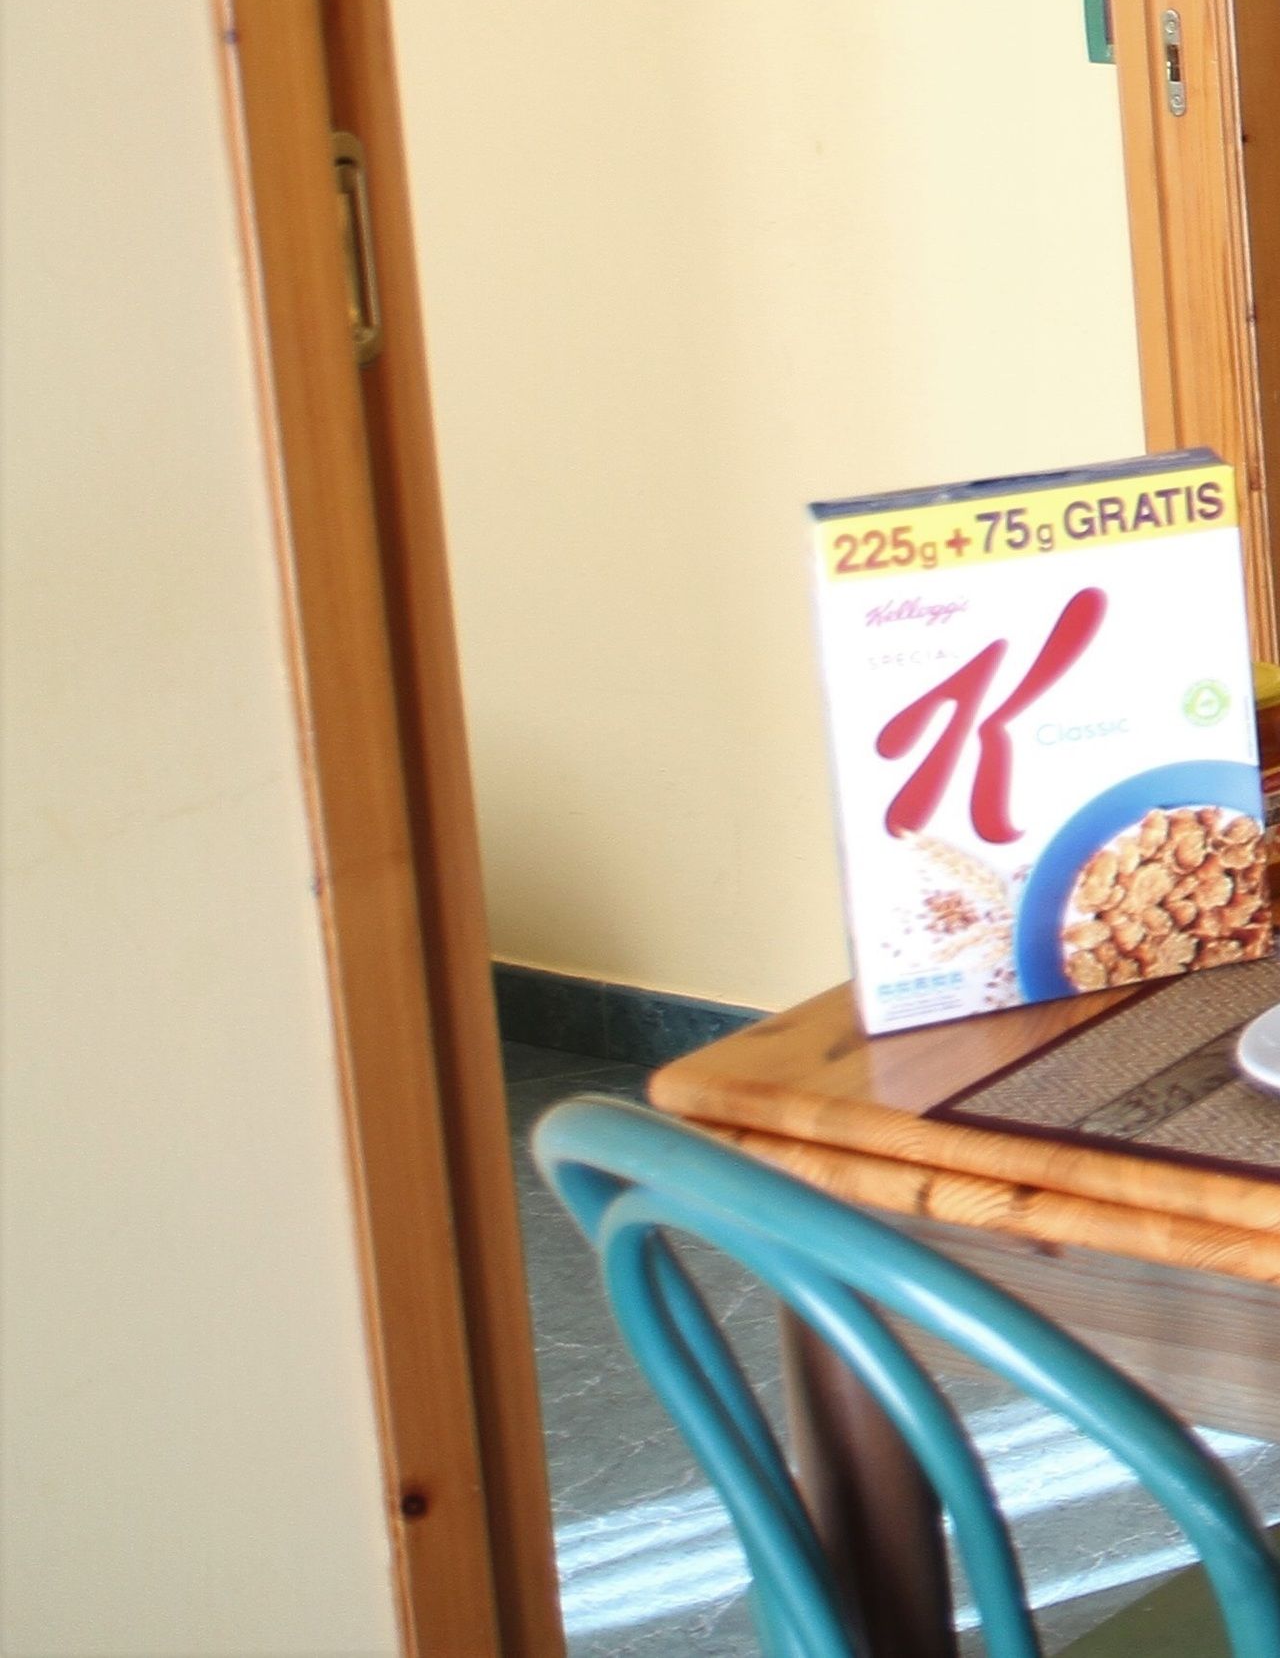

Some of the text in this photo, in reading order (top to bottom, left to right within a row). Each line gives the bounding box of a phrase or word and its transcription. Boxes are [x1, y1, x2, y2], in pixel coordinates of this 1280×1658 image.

[1062, 480, 1226, 541] GRATIS
[874, 585, 1109, 844] K
[1035, 717, 1131, 746] Classic
